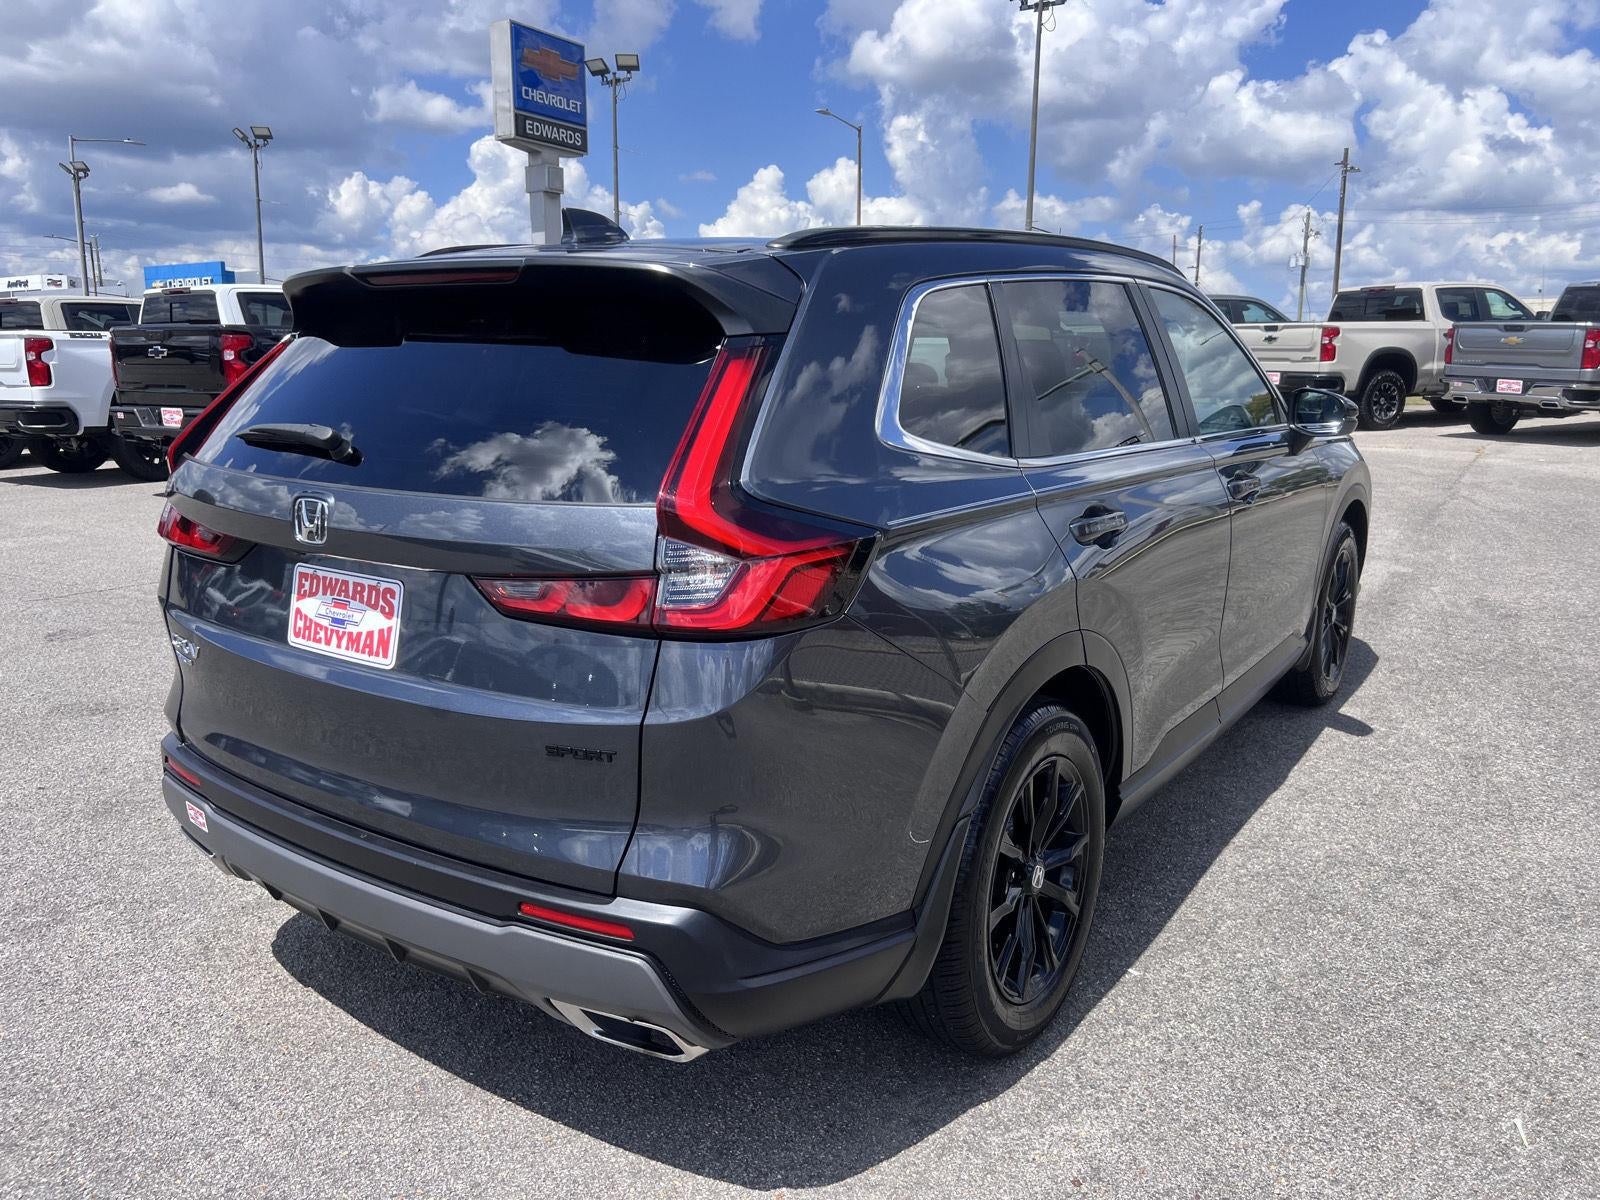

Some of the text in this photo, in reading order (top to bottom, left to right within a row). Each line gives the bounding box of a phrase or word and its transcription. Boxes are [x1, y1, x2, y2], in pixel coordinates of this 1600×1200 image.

[521, 86, 582, 114] CHEVROLET
[525, 119, 582, 146] EDWARDS
[296, 571, 397, 620] EDWARDS
[324, 607, 355, 620] Chevrolet
[292, 606, 393, 660] CHEVYMAN
[544, 744, 618, 763] SPORT
